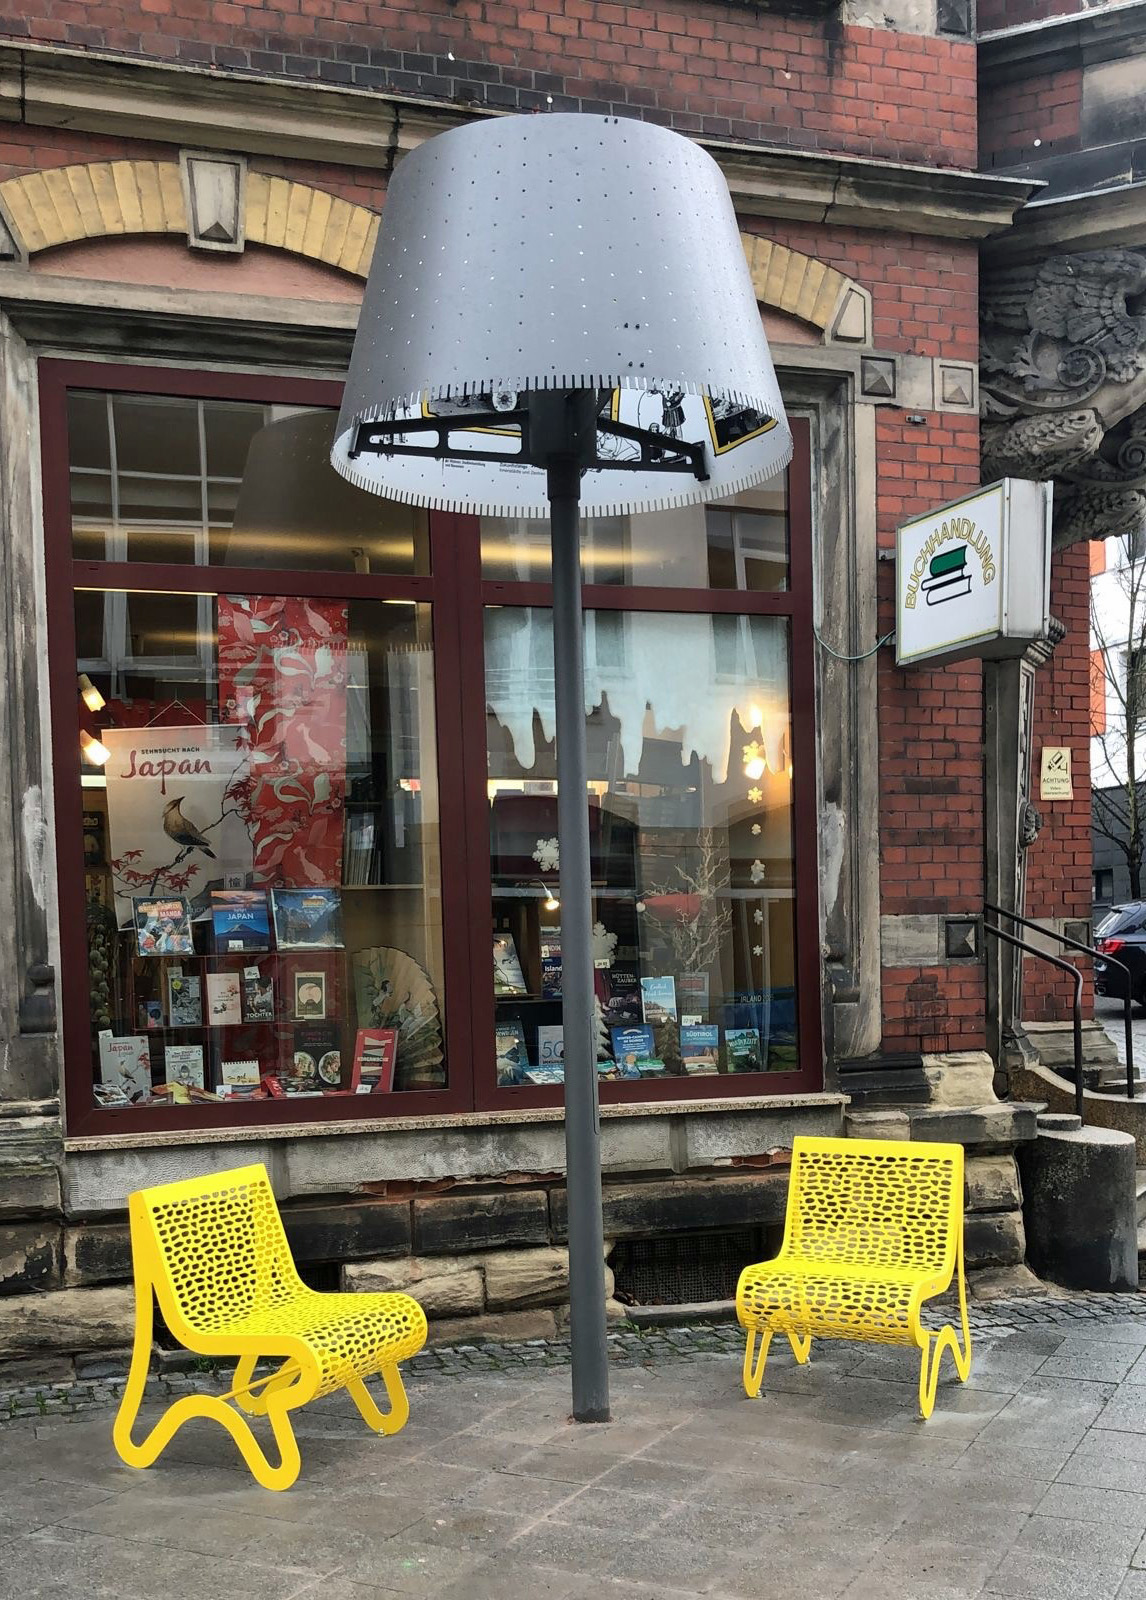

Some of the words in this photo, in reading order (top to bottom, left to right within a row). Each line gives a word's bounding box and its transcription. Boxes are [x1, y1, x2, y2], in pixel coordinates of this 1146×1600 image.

[904, 517, 996, 610] BUCHHANDLUNG
[141, 747, 180, 755] SEHNSUCHT
[120, 749, 212, 796] Japan
[226, 912, 255, 921] JAPAN
[544, 964, 563, 972] Island
[107, 1043, 134, 1055] Japan
